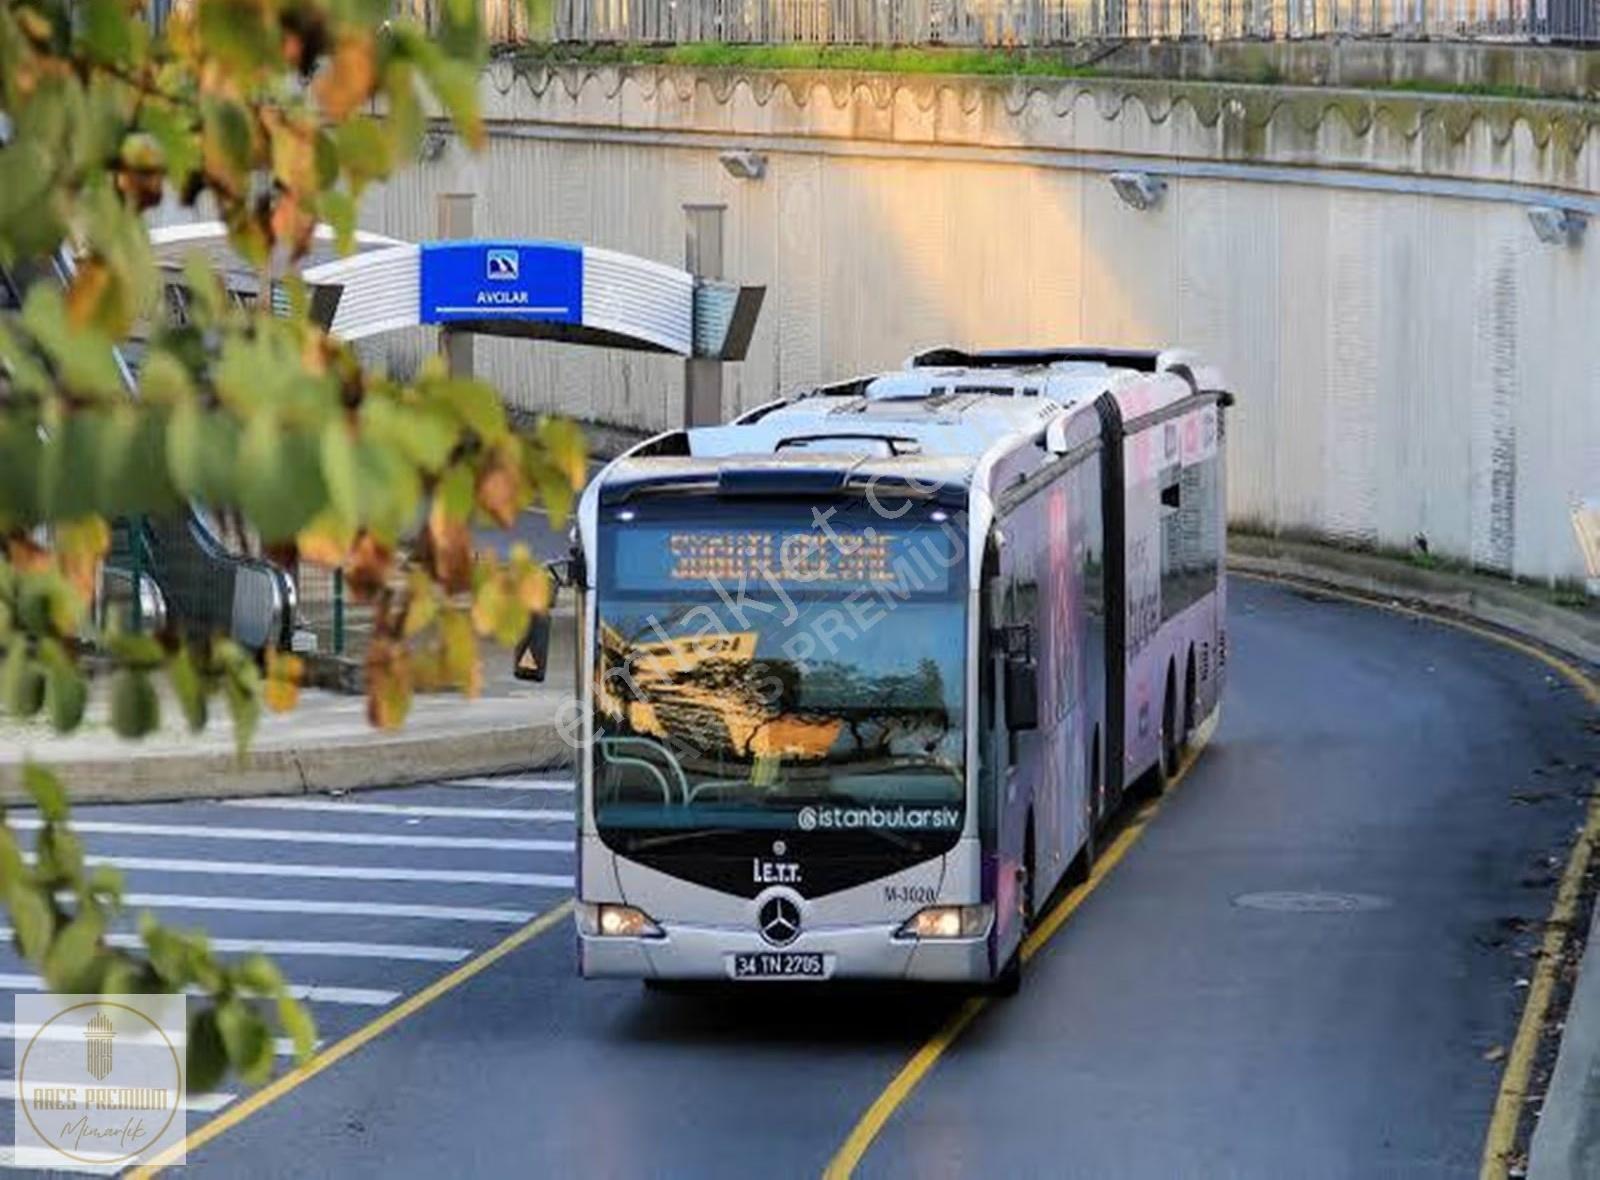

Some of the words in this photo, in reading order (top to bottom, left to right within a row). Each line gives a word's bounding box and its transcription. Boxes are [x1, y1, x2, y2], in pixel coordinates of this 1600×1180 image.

[476, 290, 529, 304] AVCILAR
[738, 956, 756, 973] 34
[760, 955, 781, 973] TN
[784, 955, 821, 973] 2705
